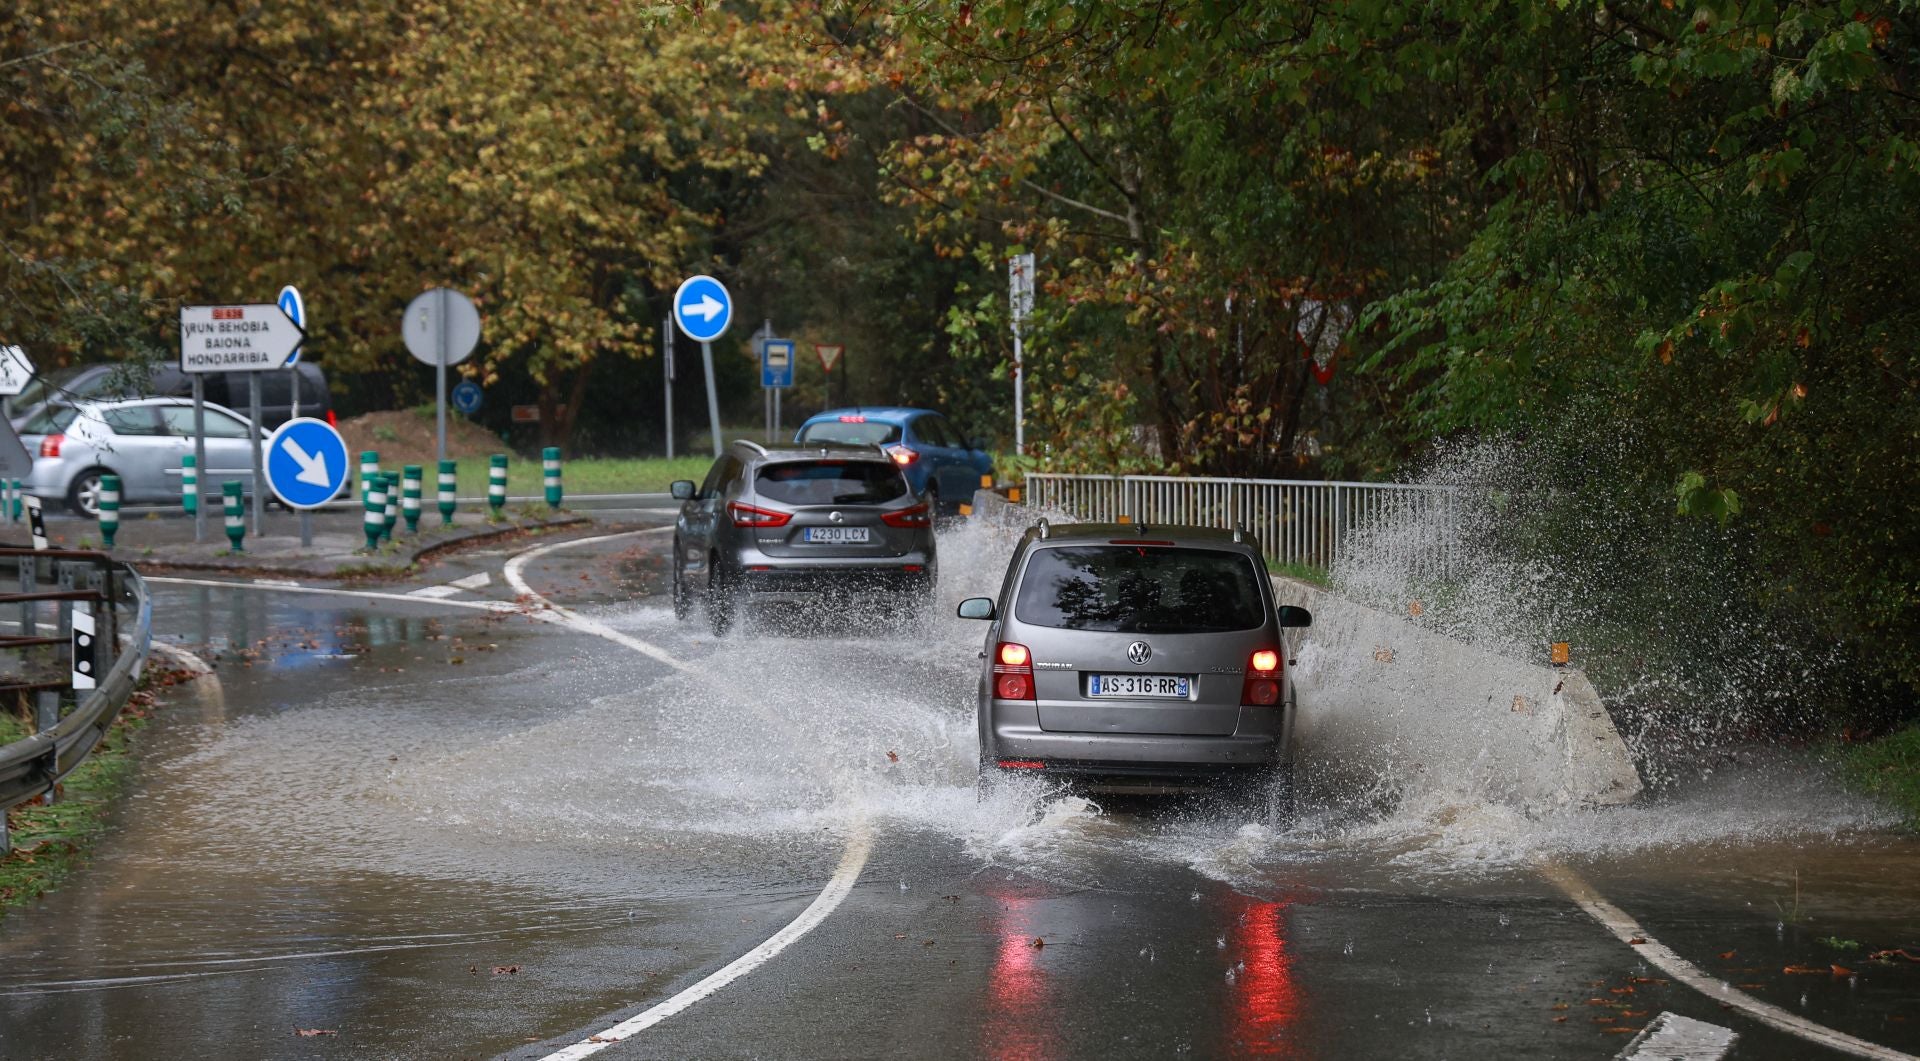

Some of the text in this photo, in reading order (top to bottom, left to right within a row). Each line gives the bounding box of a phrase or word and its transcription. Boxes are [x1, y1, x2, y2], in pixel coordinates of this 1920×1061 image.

[205, 337, 251, 349] BAIONA
[188, 352, 269, 365] HONDARRIBIA
[812, 528, 866, 540] 4230 LCX
[1102, 677, 1177, 694] AS-316-RR
